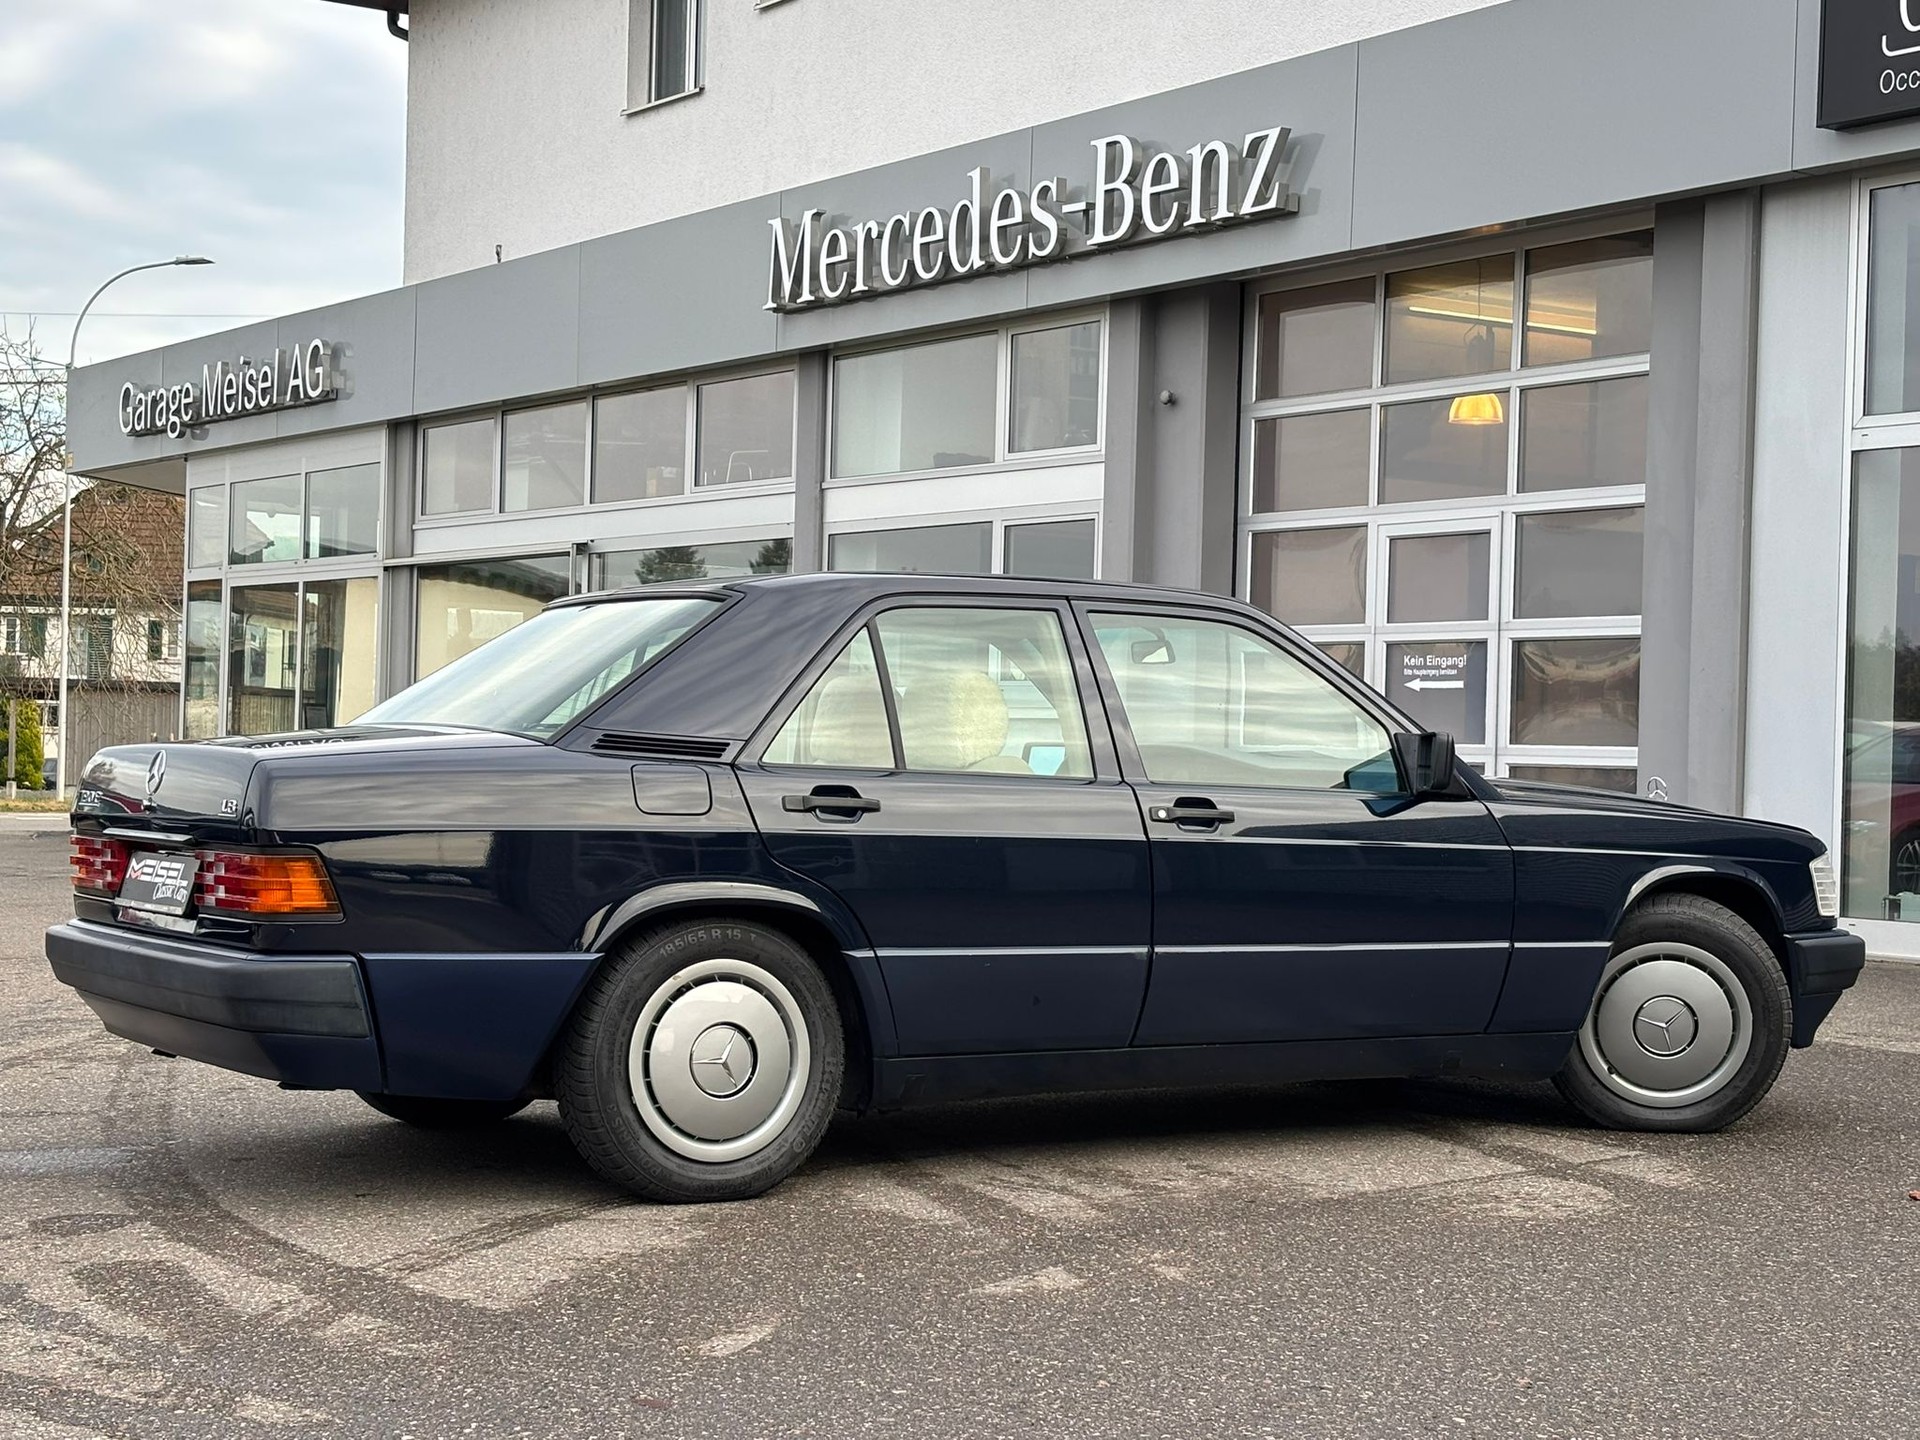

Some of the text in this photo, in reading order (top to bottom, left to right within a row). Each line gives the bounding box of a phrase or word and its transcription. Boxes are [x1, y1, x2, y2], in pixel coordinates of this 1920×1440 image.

[763, 126, 1298, 312] Mercedes-Benz
[119, 338, 328, 438] Garage Meisel AG
[1403, 654, 1467, 668] Kein Eingang!
[660, 930, 707, 957] 185/65
[711, 928, 722, 939] R
[726, 928, 742, 940] 15
